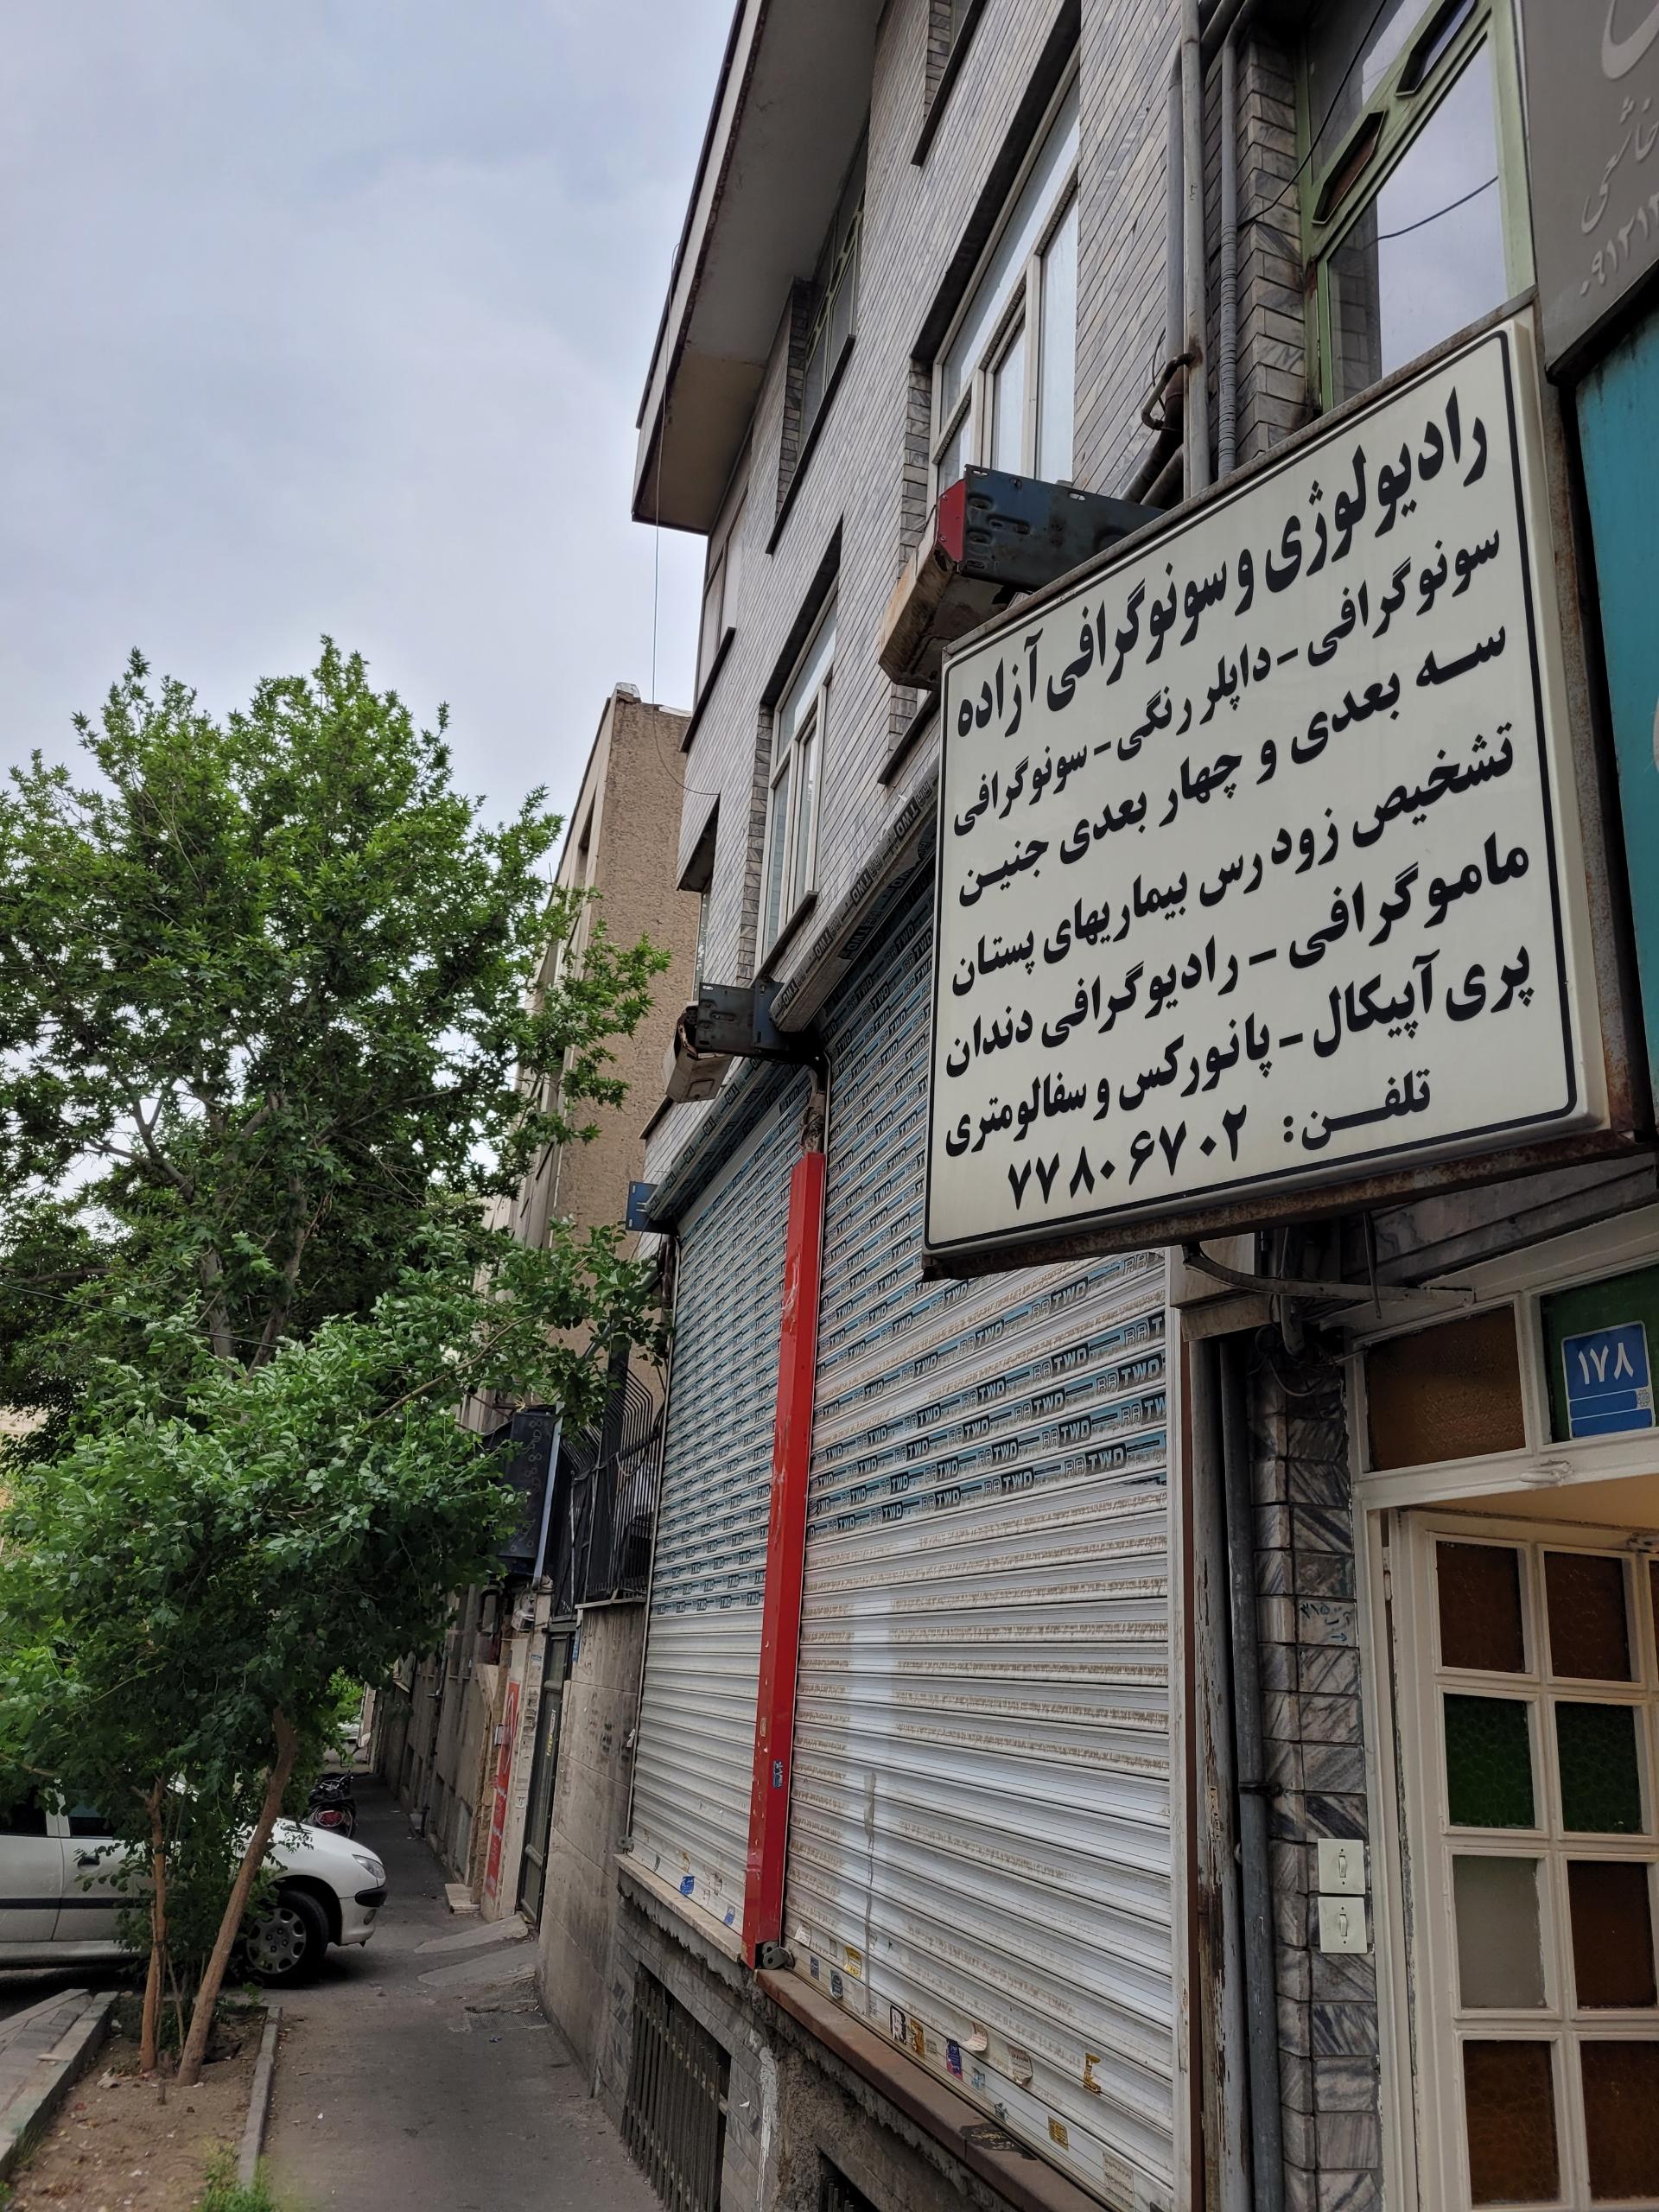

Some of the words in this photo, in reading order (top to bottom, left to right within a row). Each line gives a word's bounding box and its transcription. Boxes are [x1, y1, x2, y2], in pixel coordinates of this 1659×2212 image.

[1265, 386, 1488, 594] رادیولوژی
[1234, 548, 1255, 617] و
[1307, 530, 1500, 667] سونوگرافی
[1046, 561, 1227, 712] سونوگرافی
[957, 627, 1044, 738] آزاده
[1116, 685, 1192, 761] رنگی
[1198, 643, 1271, 726] داپلر
[1290, 672, 1401, 765] بعدی
[953, 745, 1088, 836] سونوگرافی
[1158, 754, 1243, 828] چهار
[1255, 739, 1277, 785] و
[1352, 721, 1514, 849] تشخیص
[1059, 791, 1147, 865] بعدی
[1043, 871, 1188, 964] بیماریهای
[1288, 831, 1529, 969] ماموگرافی
[952, 930, 1035, 997] پستان
[1041, 934, 1239, 1048] رادیوگرافی
[1313, 948, 1440, 1058] آپیکال
[1446, 945, 1535, 1022] پری
[948, 1005, 1033, 1078] دندان
[1118, 1012, 1273, 1111] پانورکس
[946, 1071, 1087, 1158] سفالومتری
[1092, 1077, 1110, 1122] و
[1007, 1104, 1247, 1211] ۷۷۸۰۶۷۰۲
[1578, 1342, 1634, 1385] ۱۷۸
